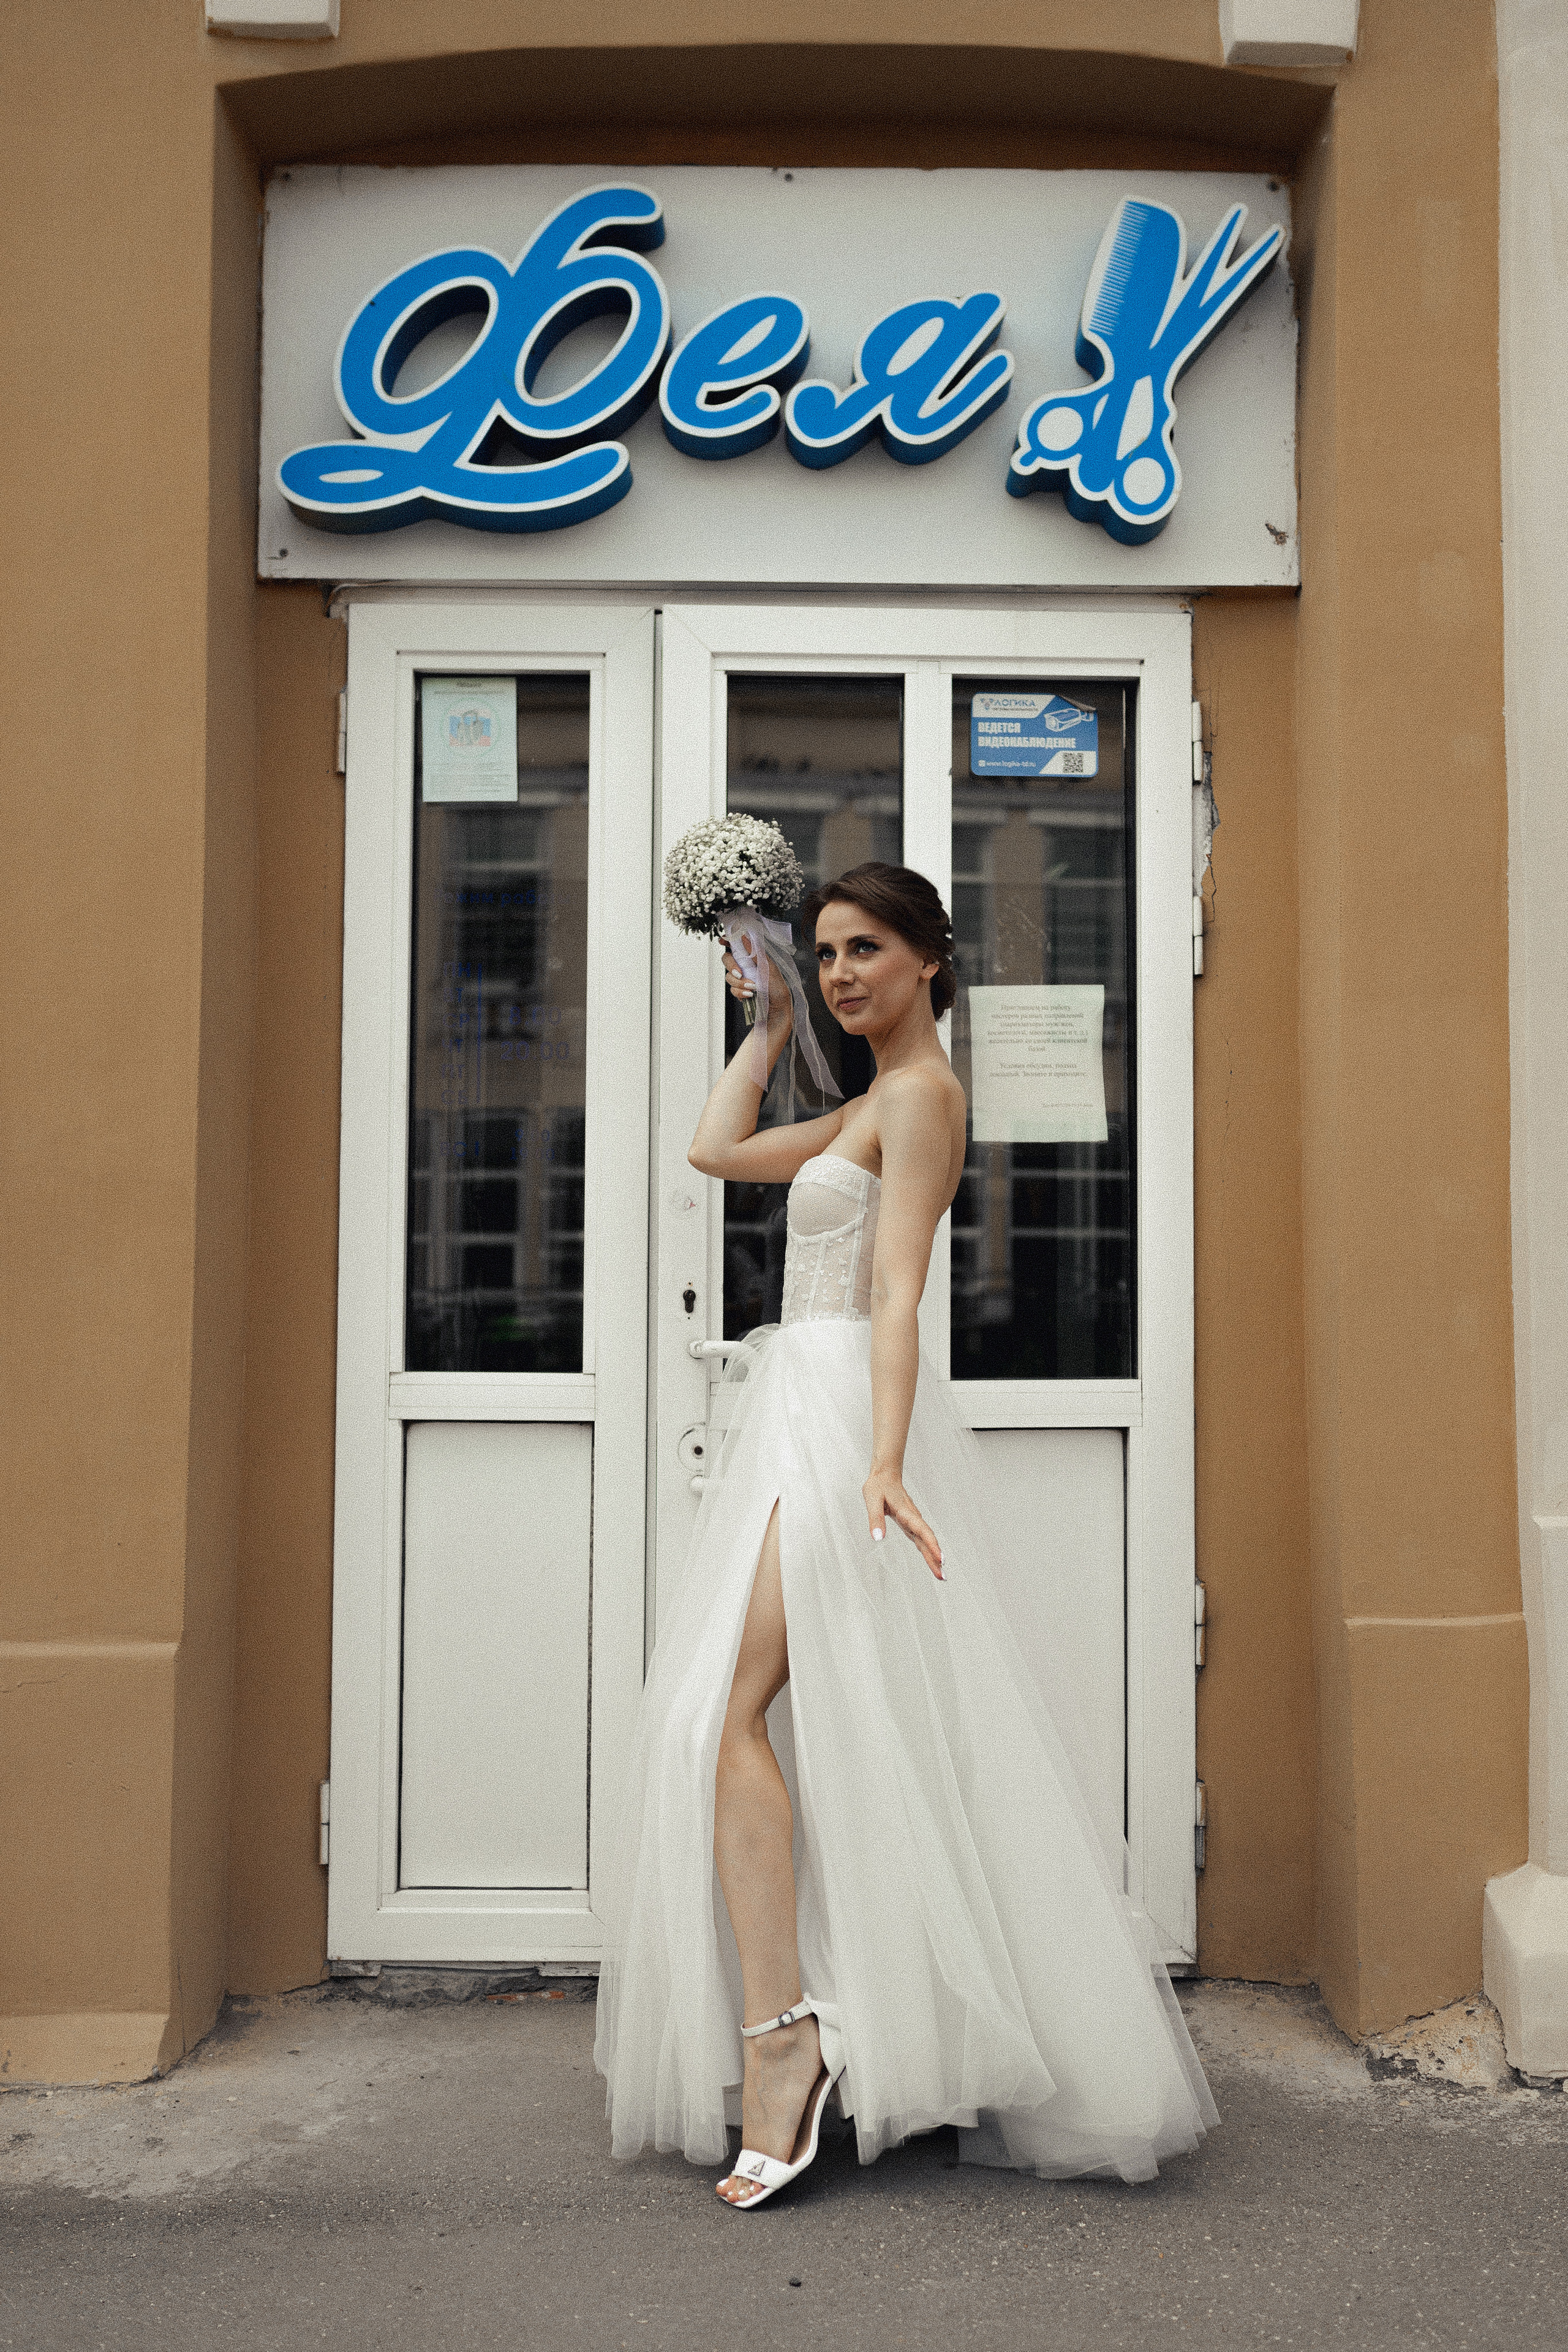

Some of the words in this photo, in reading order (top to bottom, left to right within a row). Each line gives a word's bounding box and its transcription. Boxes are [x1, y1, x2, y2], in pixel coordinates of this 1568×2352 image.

[277, 183, 1014, 528] Фея
[993, 698, 1036, 707] ЛОГИКА
[978, 722, 1021, 734] ВЕДЕТСЯ
[978, 736, 1076, 749] ВИДЕОНАБЛЮДЕНИЕ
[500, 1041, 570, 1061] 20.00
